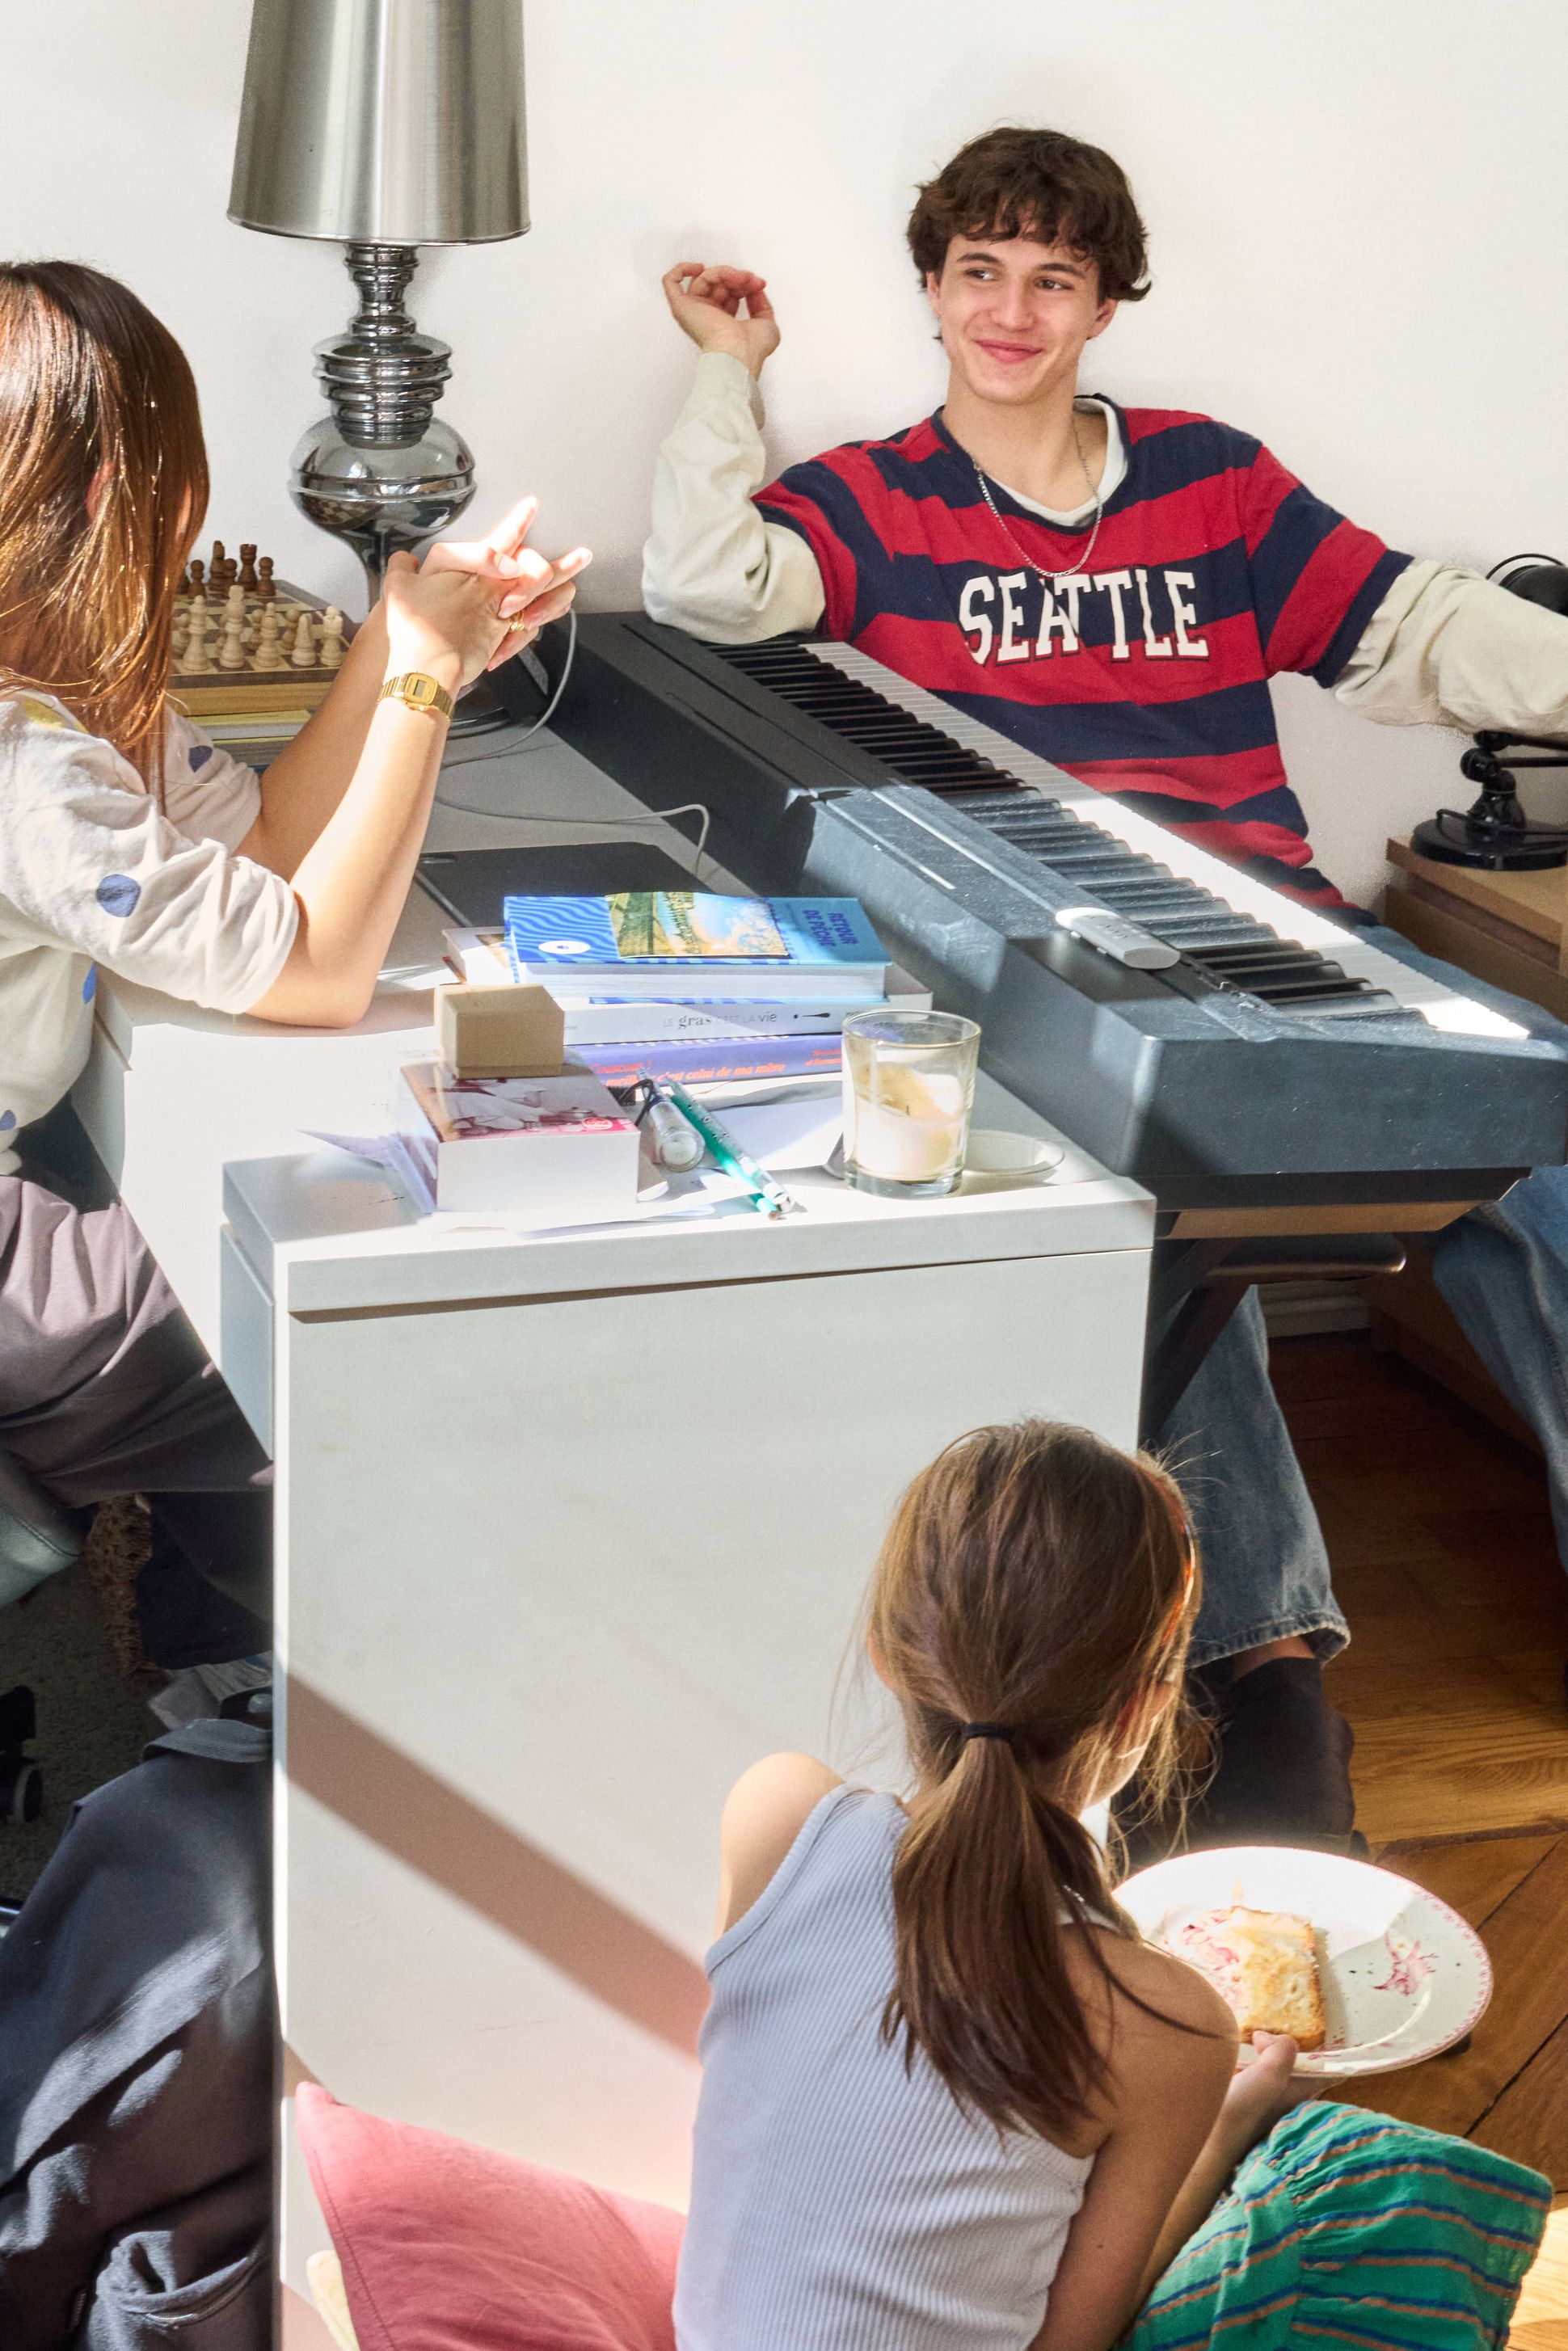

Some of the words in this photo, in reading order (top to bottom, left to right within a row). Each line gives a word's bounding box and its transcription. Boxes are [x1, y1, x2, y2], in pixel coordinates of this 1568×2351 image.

[959, 568, 1210, 667] SEATTLE
[802, 910, 823, 920] DE
[808, 921, 836, 946] PÊCHE
[828, 912, 858, 945] RETOUR
[677, 1014, 711, 1030] gras
[757, 1011, 778, 1023] vie
[685, 1067, 715, 1080] celui
[716, 1065, 732, 1077] de
[733, 1065, 754, 1076] ma
[755, 1061, 786, 1074] mère
